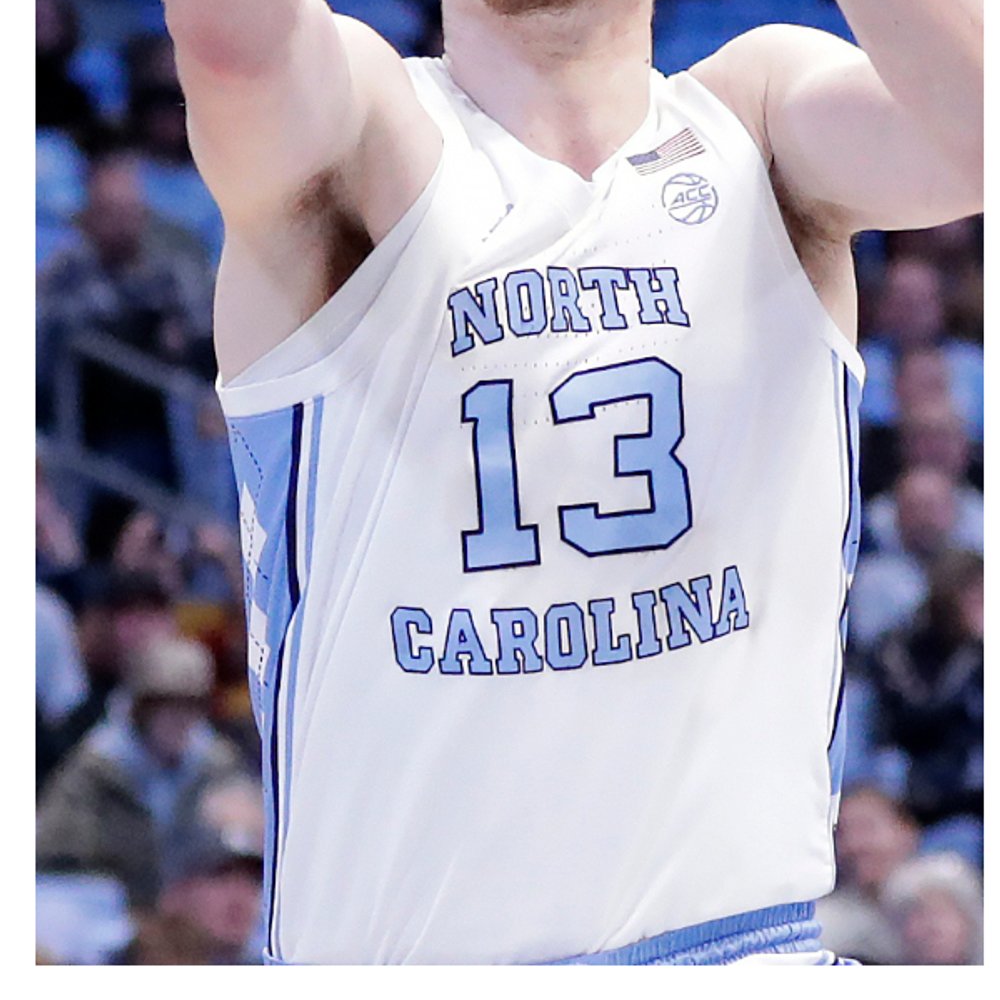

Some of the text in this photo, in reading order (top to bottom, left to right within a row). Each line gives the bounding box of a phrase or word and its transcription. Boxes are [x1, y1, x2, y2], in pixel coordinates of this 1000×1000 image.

[671, 184, 711, 205] ACC
[447, 266, 690, 357] NORTH
[461, 356, 692, 573] 13
[390, 565, 750, 675] CAROLINA
